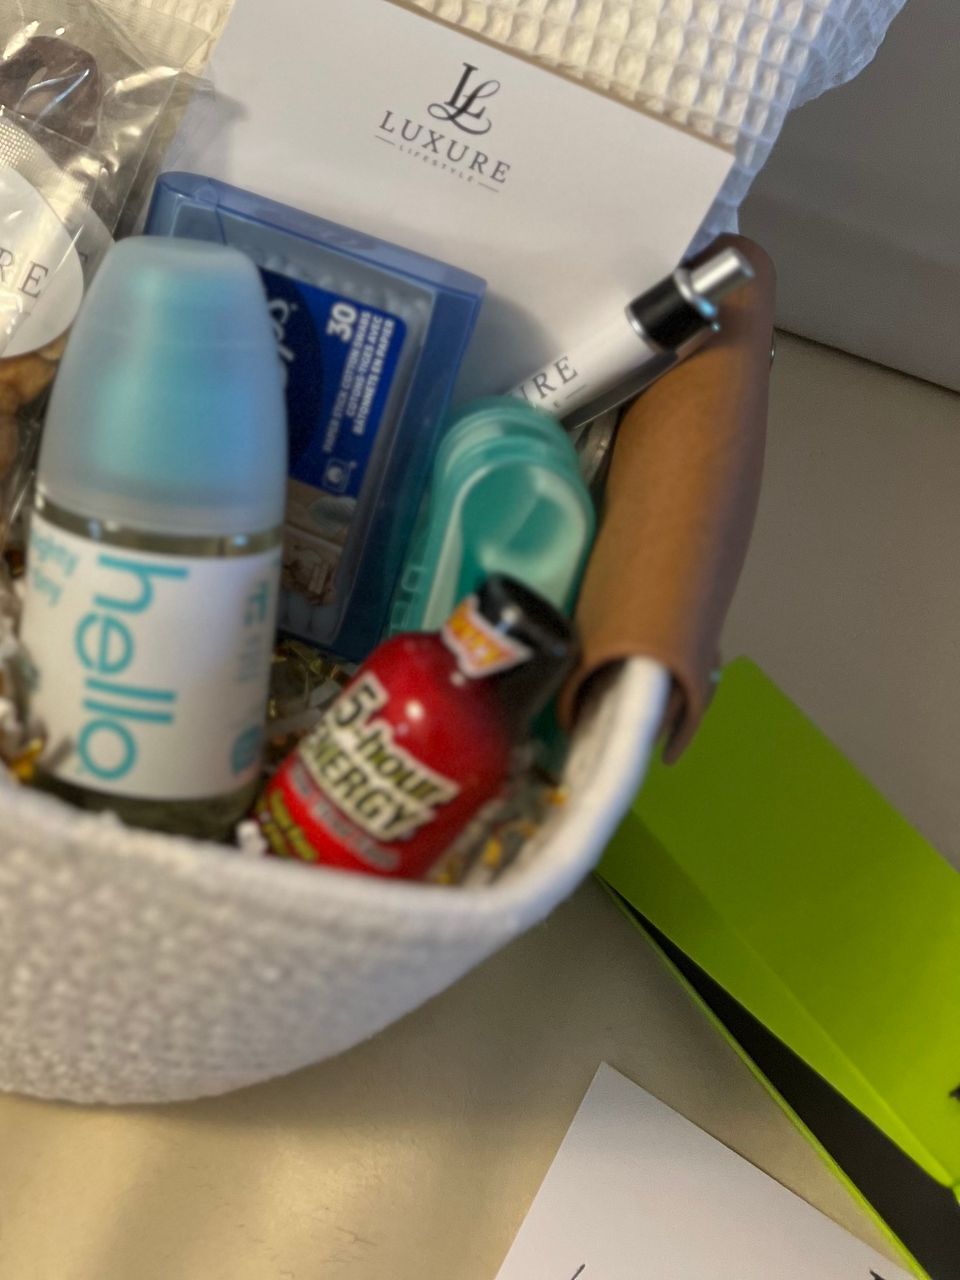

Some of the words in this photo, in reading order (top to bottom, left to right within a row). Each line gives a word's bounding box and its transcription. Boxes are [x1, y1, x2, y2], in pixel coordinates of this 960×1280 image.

[379, 110, 511, 184] LUXURE
[325, 301, 358, 342] 30
[367, 314, 384, 344] AVEC
[375, 319, 396, 357] PAPIER
[341, 348, 360, 390] COTTON
[353, 310, 372, 349] SWABS
[370, 356, 385, 373] EN
[74, 553, 189, 782] hello
